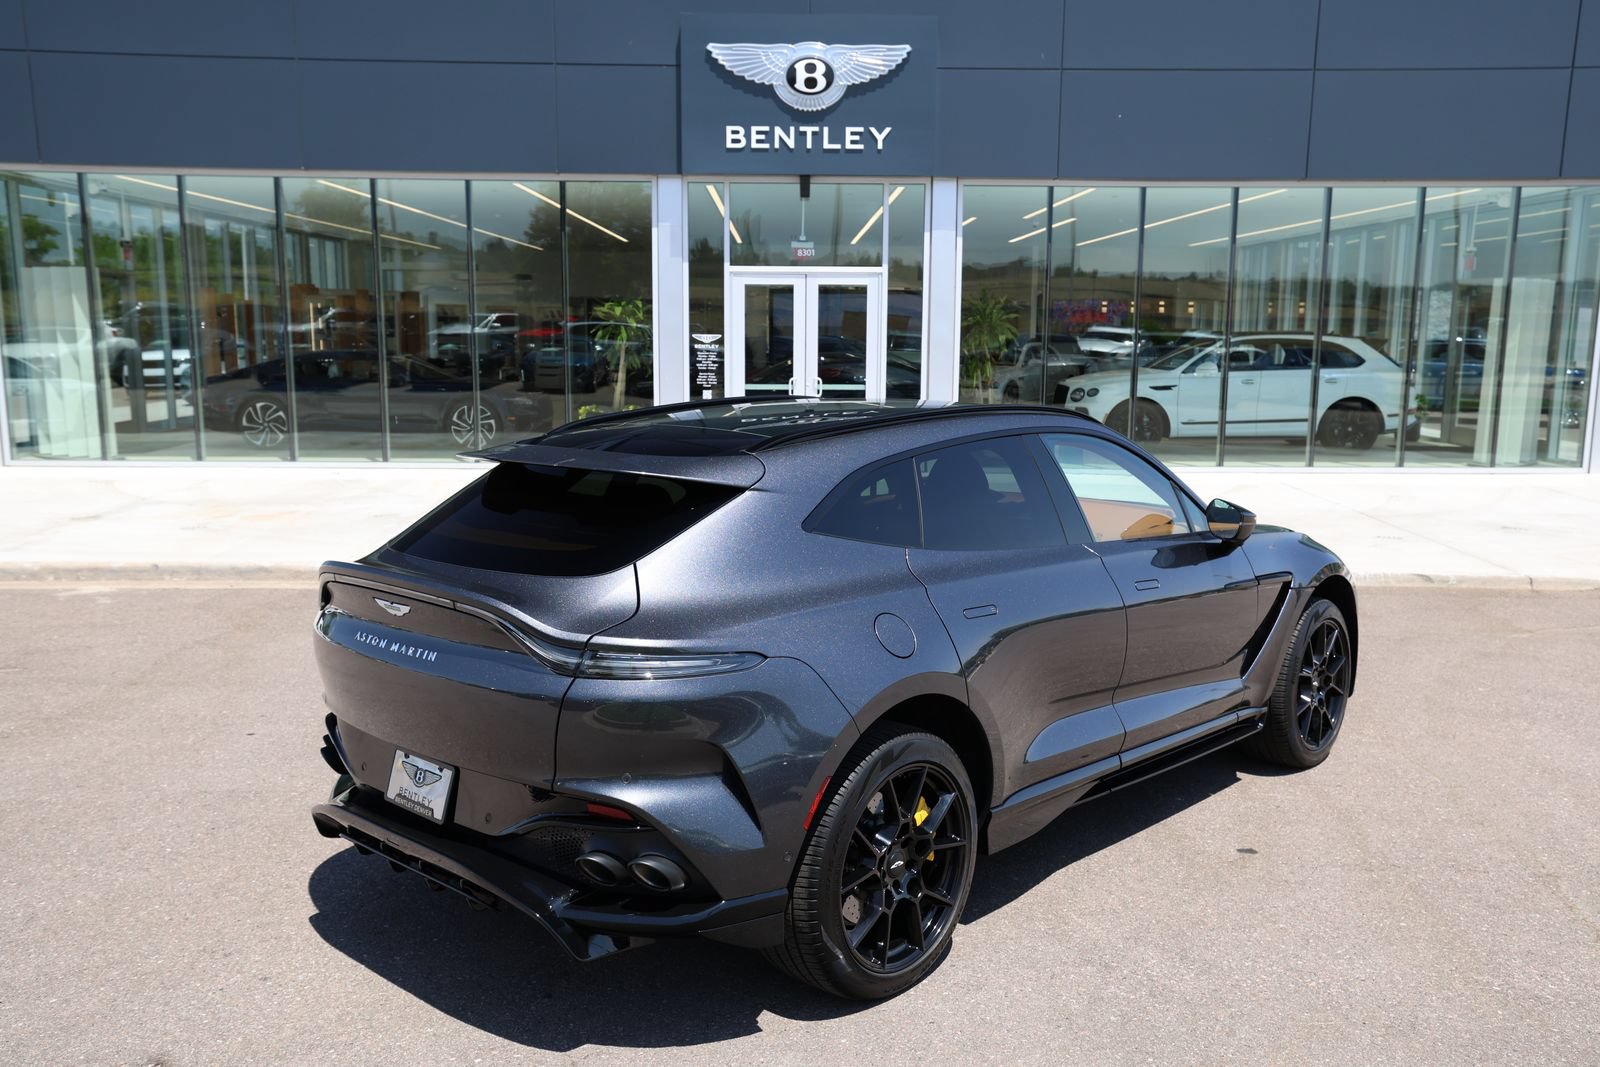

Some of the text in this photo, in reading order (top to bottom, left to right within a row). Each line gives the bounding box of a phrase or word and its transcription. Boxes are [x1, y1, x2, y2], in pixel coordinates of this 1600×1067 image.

[794, 58, 827, 94] B
[725, 125, 893, 150] BENTLEY
[797, 248, 815, 257] 8301
[354, 631, 438, 662] ASTON MARTIN
[395, 796, 432, 816] BENTLEY DENVER
[398, 786, 433, 807] BENTLEY
